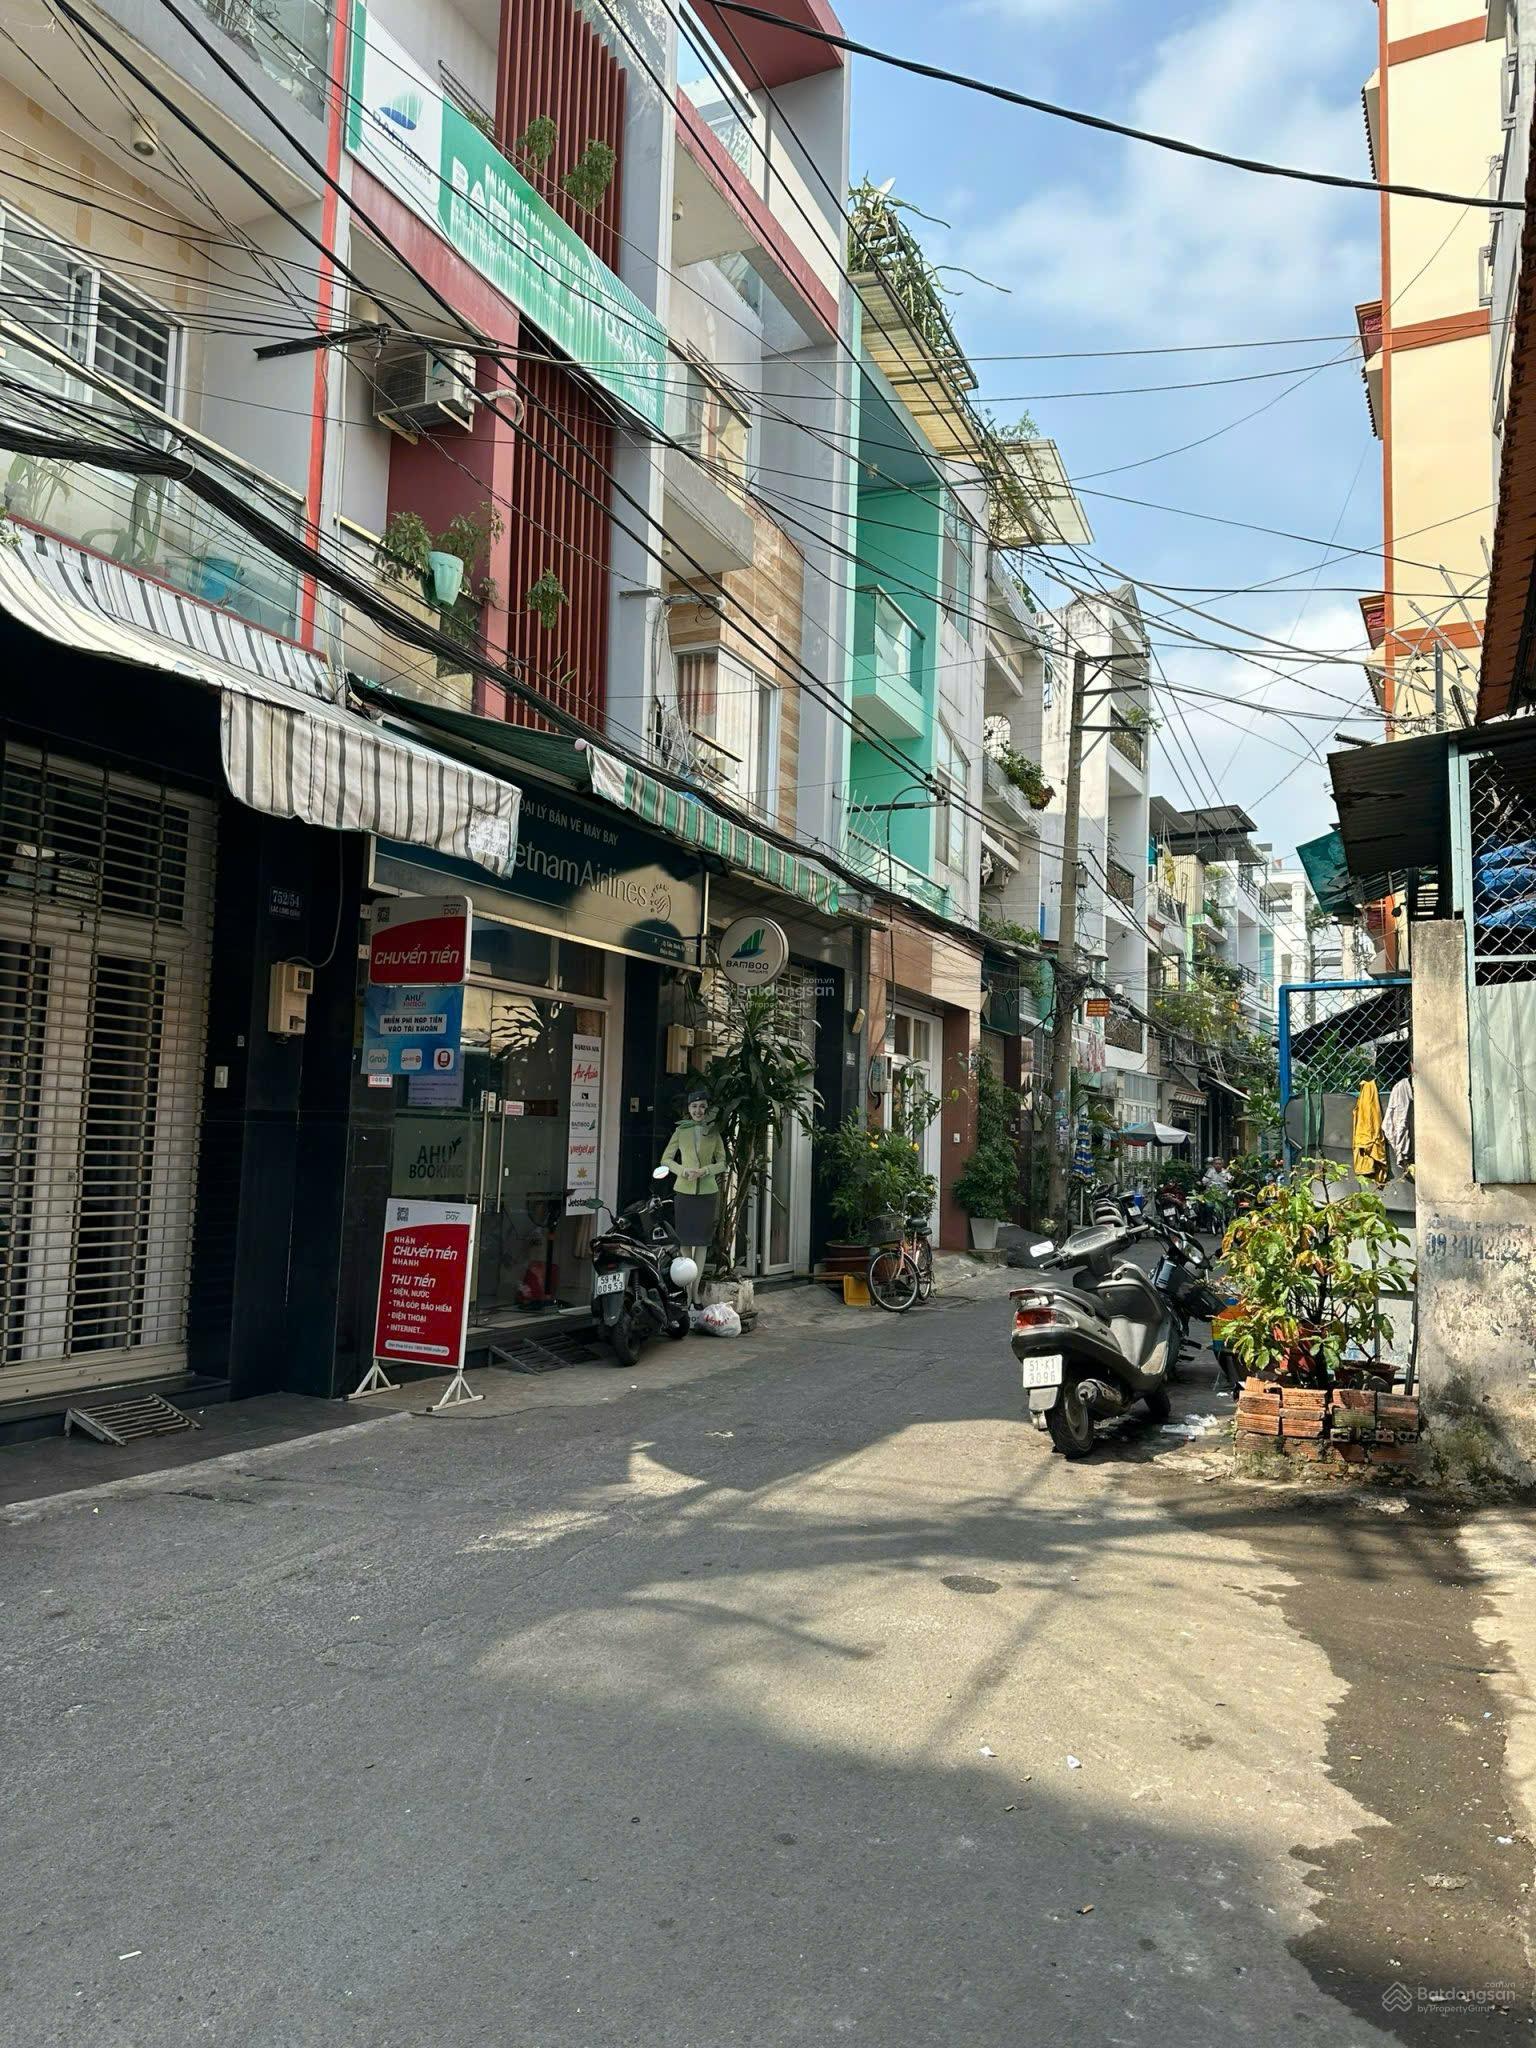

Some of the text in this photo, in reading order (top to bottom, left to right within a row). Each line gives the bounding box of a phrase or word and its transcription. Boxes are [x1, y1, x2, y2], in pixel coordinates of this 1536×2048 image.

[537, 804, 547, 820] LÝ
[549, 807, 568, 828] BÁN
[584, 822, 601, 841] MÁY
[603, 830, 619, 847] BAY
[516, 841, 647, 907] etnam Airlines
[725, 960, 770, 971] BAMBOO
[369, 1055, 387, 1063] Grab
[394, 1235, 416, 1246] NHẬN
[392, 1258, 420, 1267] NHANH
[391, 1273, 412, 1286] THU
